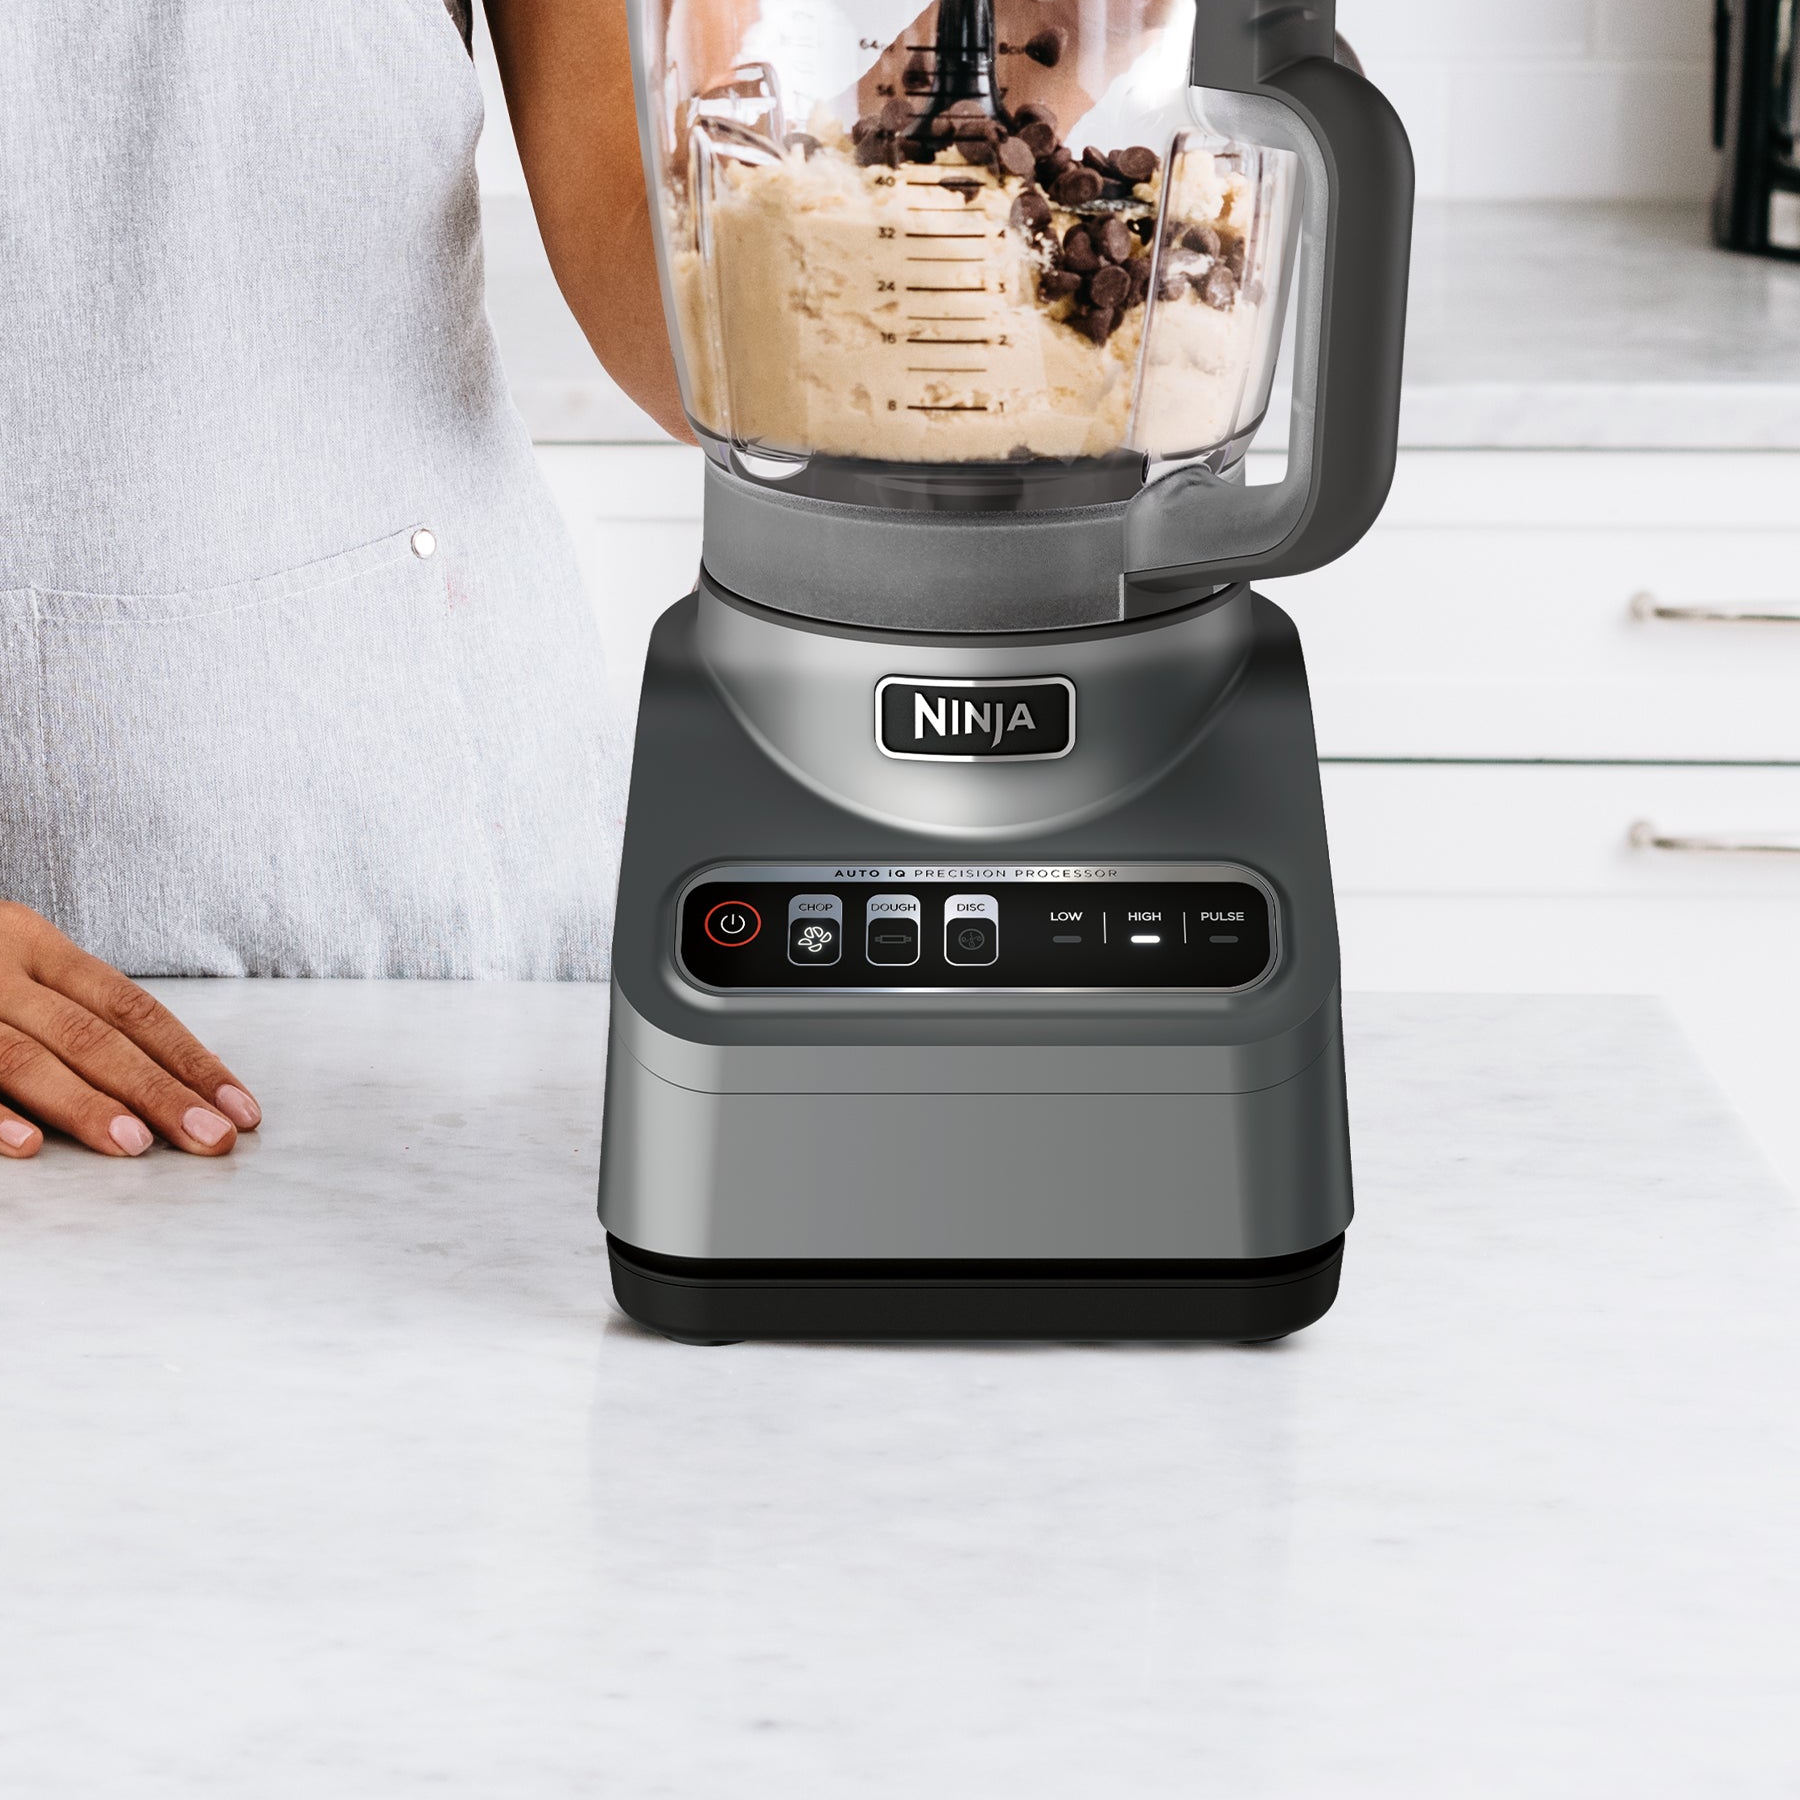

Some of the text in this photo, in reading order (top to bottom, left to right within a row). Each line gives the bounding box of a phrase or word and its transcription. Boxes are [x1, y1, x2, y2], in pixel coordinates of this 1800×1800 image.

[875, 176, 896, 187] 40
[878, 227, 896, 239] 32
[997, 230, 1007, 239] 4
[877, 281, 896, 292] 24
[998, 282, 1007, 293] 3
[880, 332, 897, 344] 16
[999, 335, 1008, 346] 2
[887, 400, 897, 411] 8
[834, 869, 880, 878] AUTO
[914, 869, 1006, 878] PRECISION
[1015, 869, 1118, 878] PROCESSOR
[798, 903, 833, 912] CHOP
[871, 903, 917, 912] DOUGH
[956, 903, 986, 912] DISC
[1050, 911, 1083, 922] LOW
[1128, 911, 1162, 922] HIGH
[1200, 911, 1245, 922] PULSE
